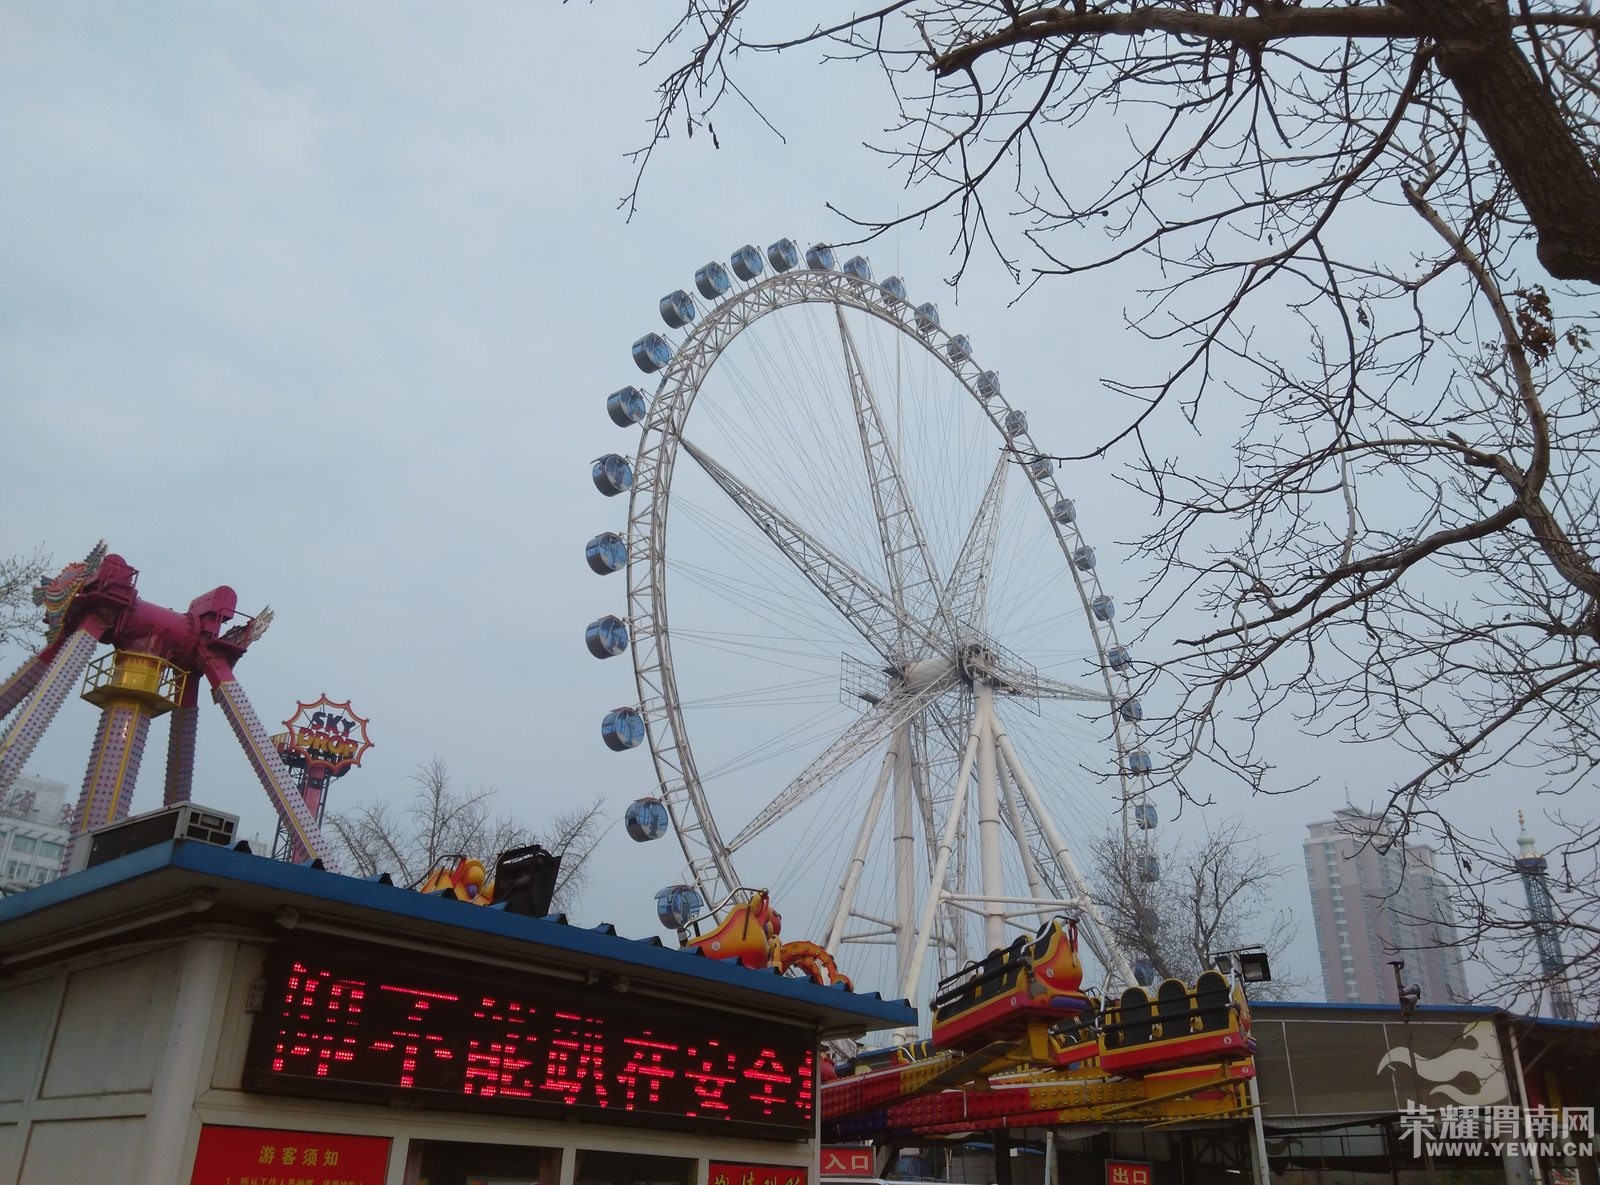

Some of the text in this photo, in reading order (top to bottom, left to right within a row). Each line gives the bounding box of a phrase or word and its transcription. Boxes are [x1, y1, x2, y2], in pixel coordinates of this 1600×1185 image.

[310, 711, 356, 739] SKY
[297, 726, 359, 760] DROP
[258, 1145, 339, 1167] 游客须知
[824, 1153, 869, 1171] 入口
[1112, 1167, 1148, 1185] 出口
